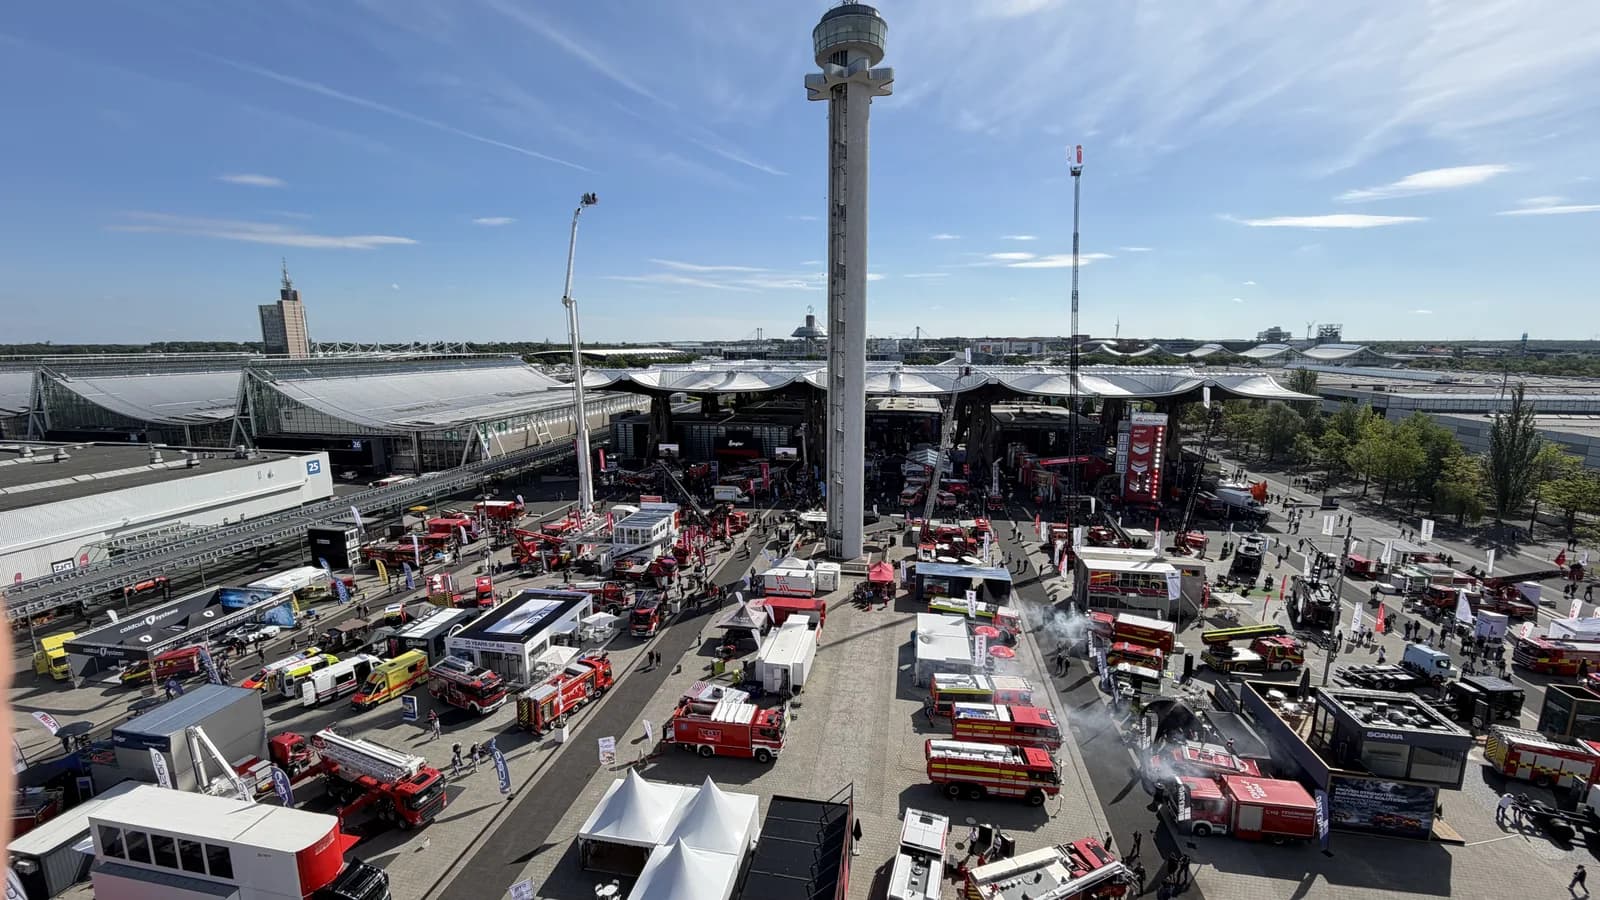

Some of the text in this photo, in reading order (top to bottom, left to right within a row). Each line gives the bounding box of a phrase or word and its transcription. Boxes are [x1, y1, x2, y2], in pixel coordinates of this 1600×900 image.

[352, 440, 361, 448] 26
[308, 462, 319, 471] 25
[119, 608, 178, 634] coldcut systems
[1366, 731, 1404, 740] SCANIA
